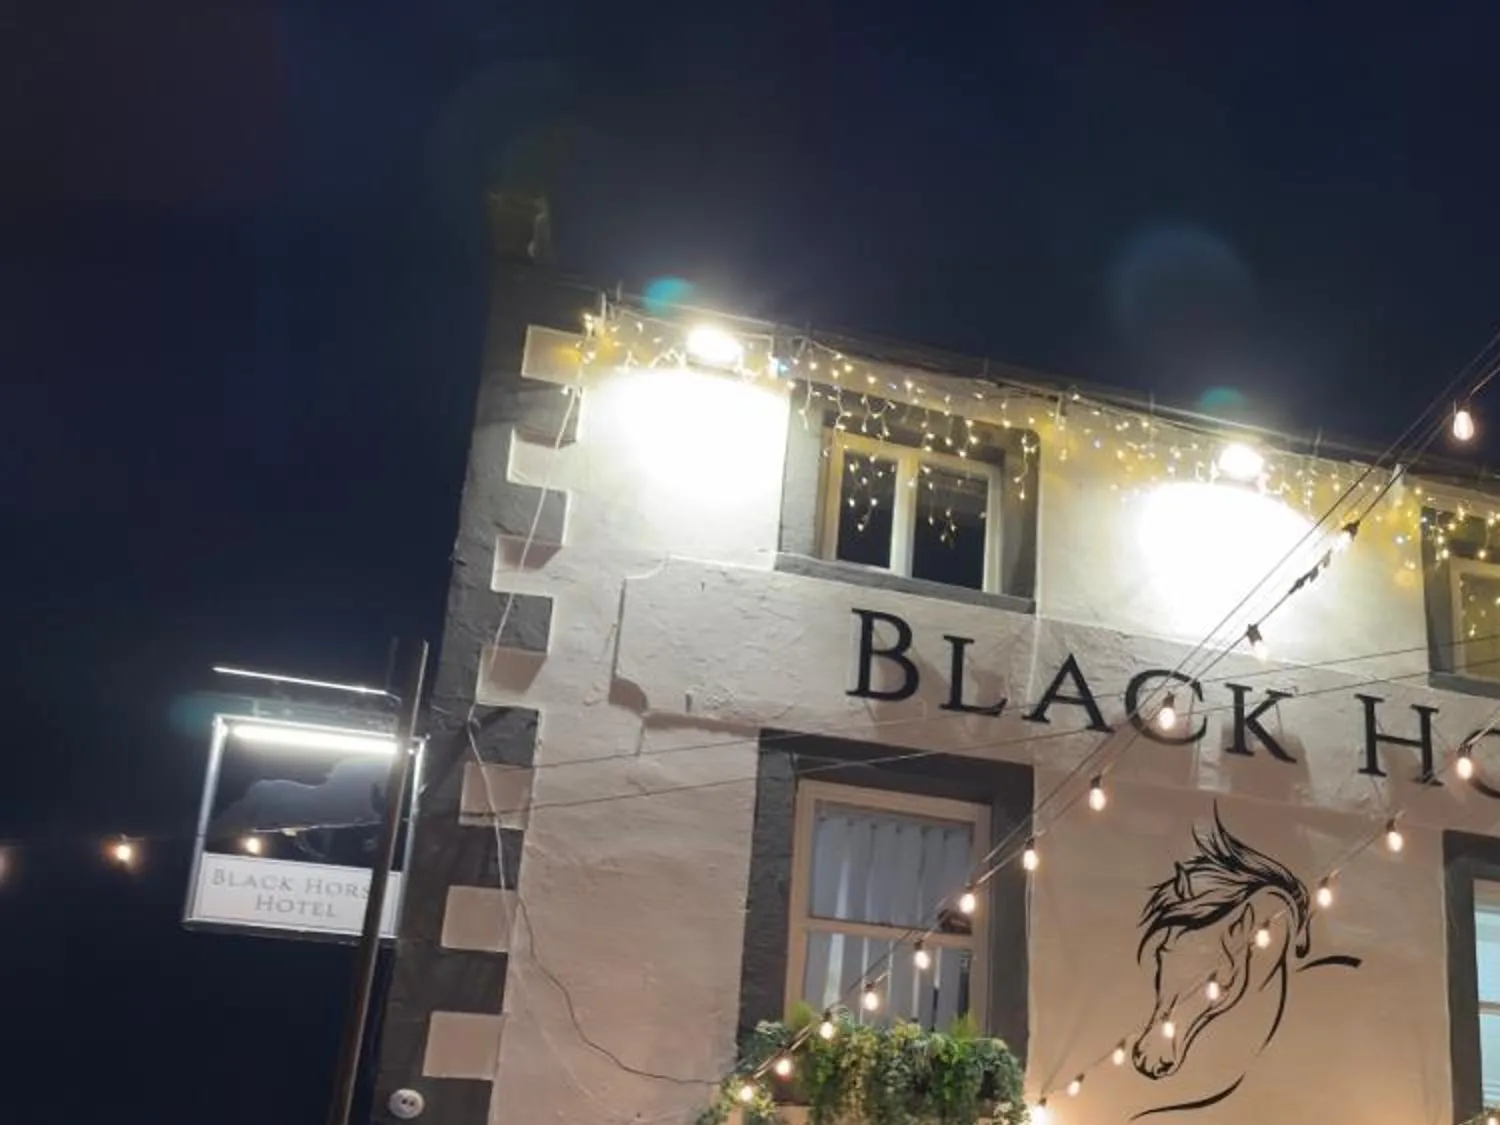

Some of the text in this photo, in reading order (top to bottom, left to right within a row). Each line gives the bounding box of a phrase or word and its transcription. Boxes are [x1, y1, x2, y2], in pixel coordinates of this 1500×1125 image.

[846, 607, 1298, 764] BLACK
[211, 868, 369, 900] BLACK HORS
[254, 894, 337, 919] HOTEL
